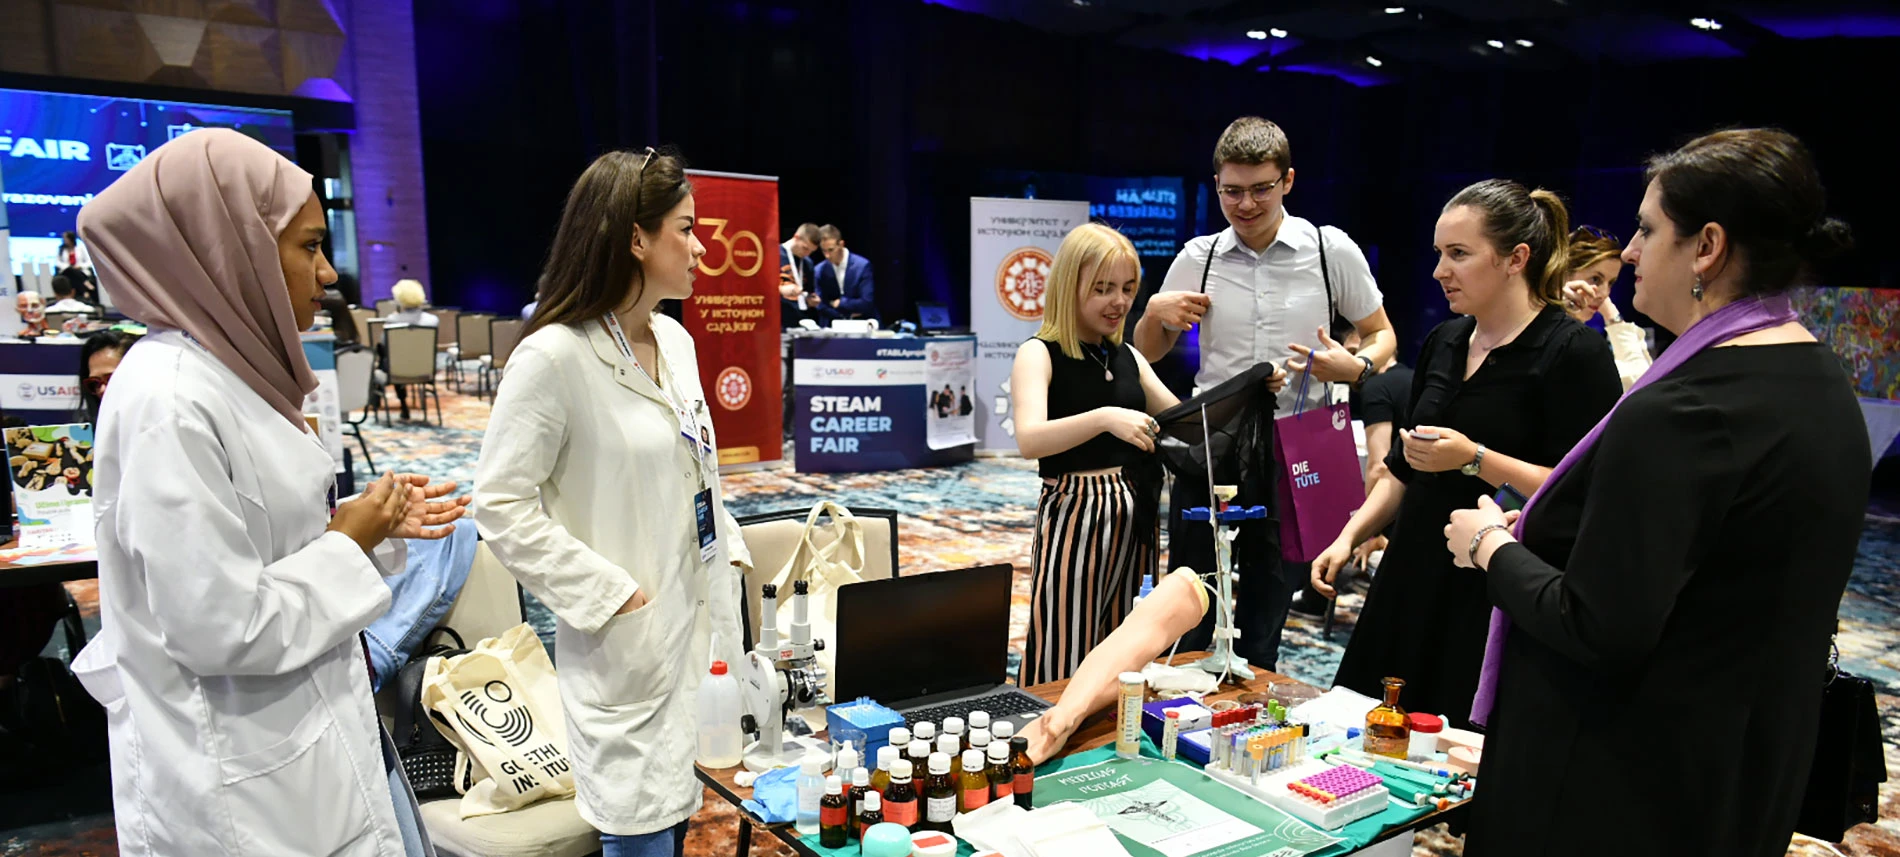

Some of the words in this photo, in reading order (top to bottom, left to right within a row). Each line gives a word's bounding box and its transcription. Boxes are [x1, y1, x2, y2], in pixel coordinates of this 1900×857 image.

[698, 217, 764, 277] 30
[810, 396, 882, 413] STEAM
[810, 416, 892, 433] CAREER
[810, 437, 860, 453] FAIR
[1292, 460, 1310, 476] DIE
[1295, 472, 1320, 489] TÜTE
